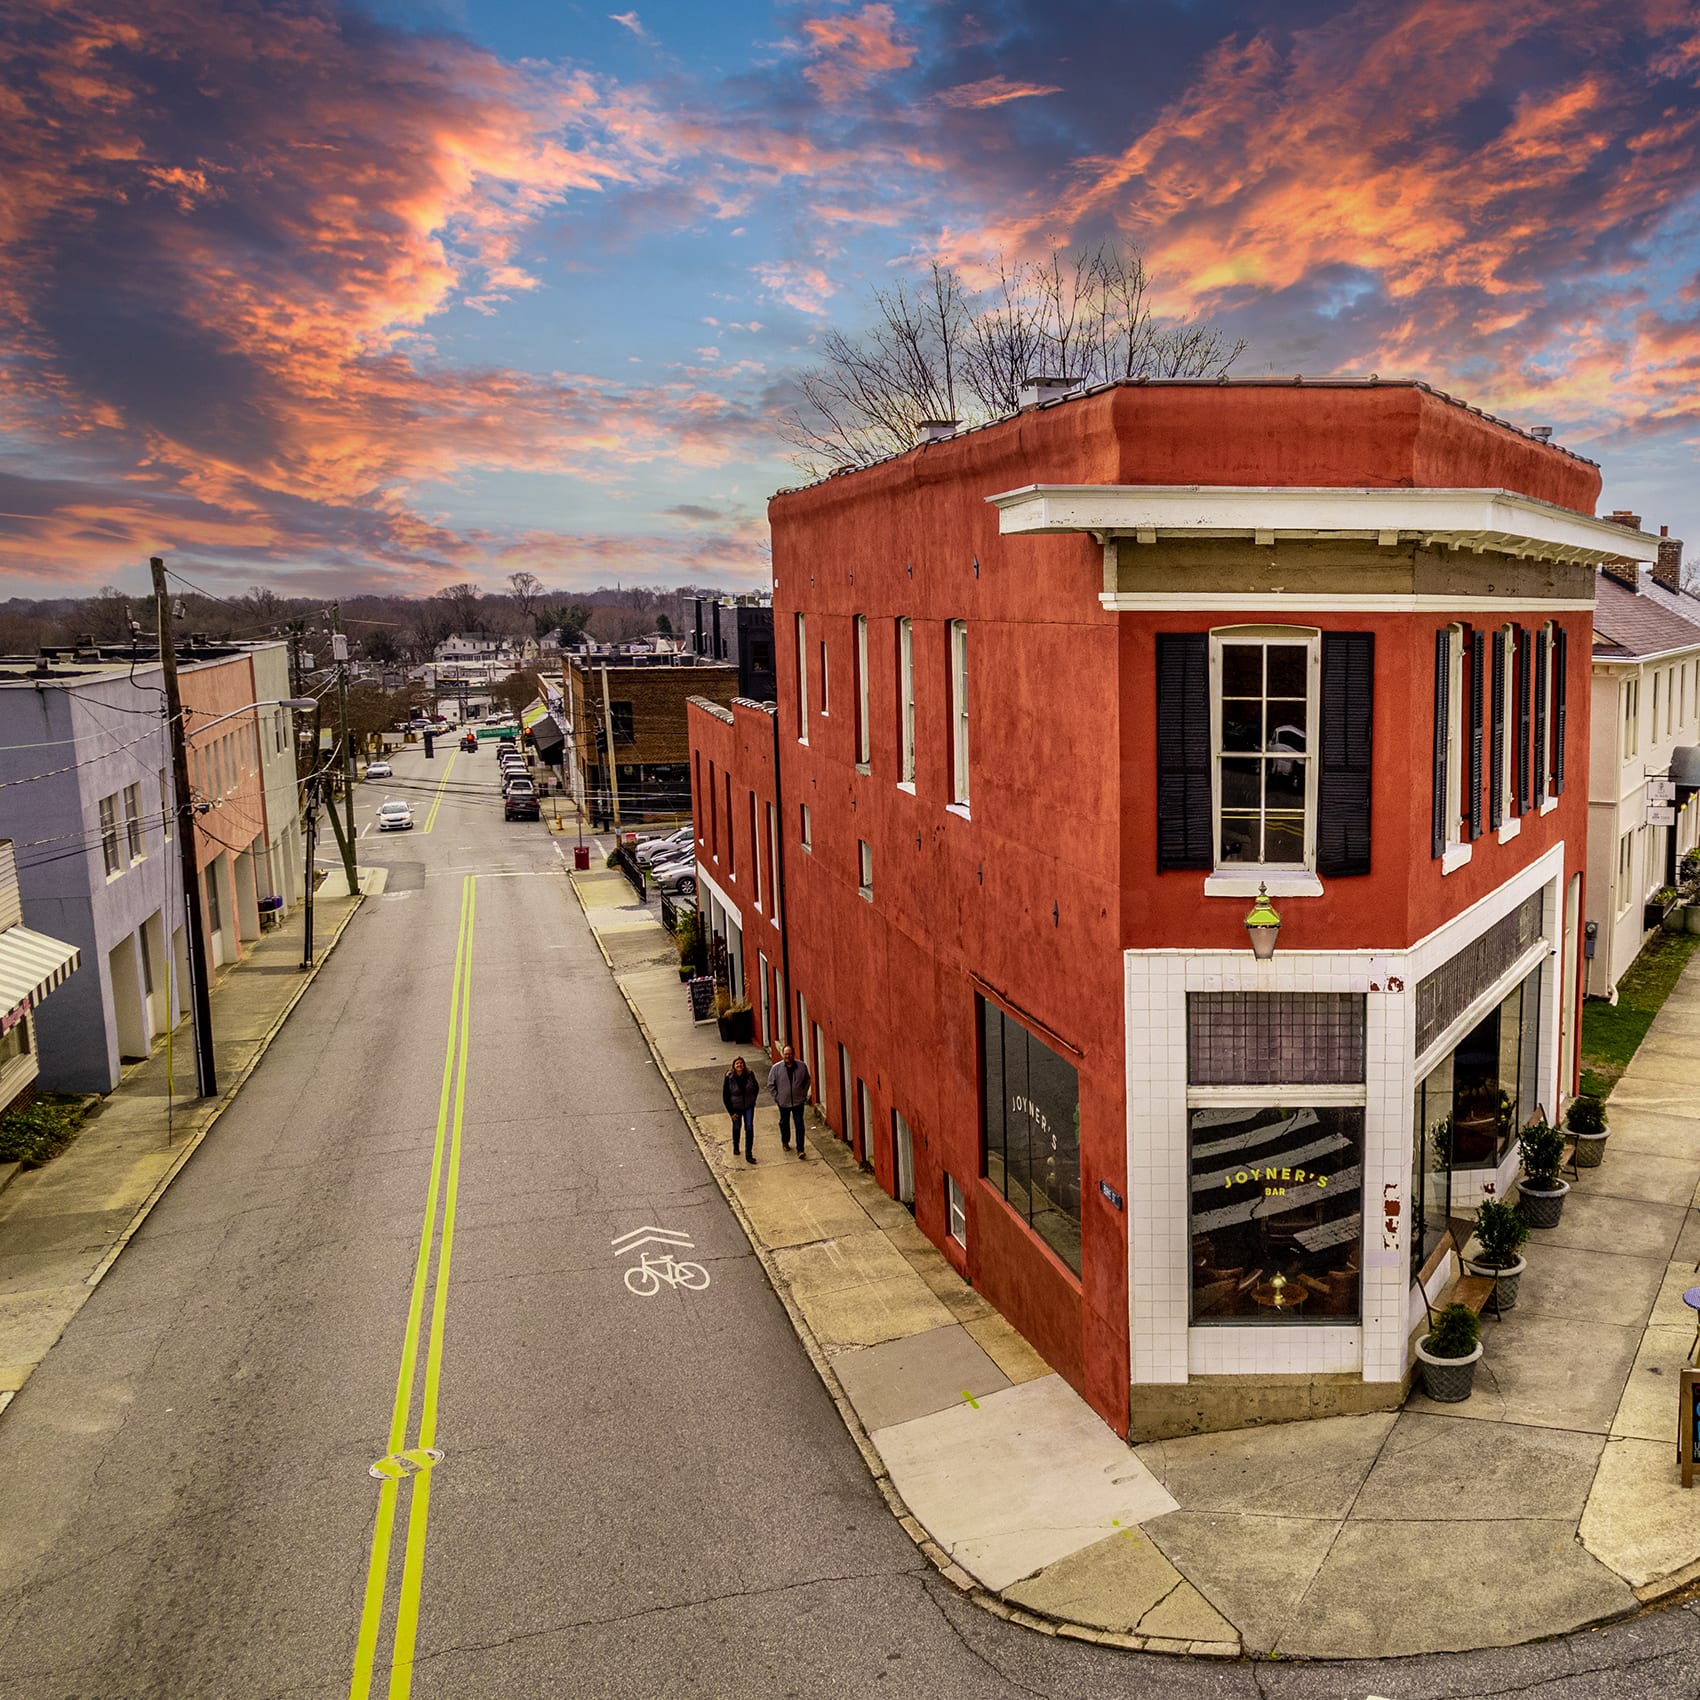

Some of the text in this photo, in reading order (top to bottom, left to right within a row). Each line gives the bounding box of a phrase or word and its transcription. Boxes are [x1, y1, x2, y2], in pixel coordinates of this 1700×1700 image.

[1012, 1095, 1057, 1151] JOYNER'S
[1225, 1167, 1329, 1189] JOYNER'S
[1264, 1187, 1286, 1196] BAR
